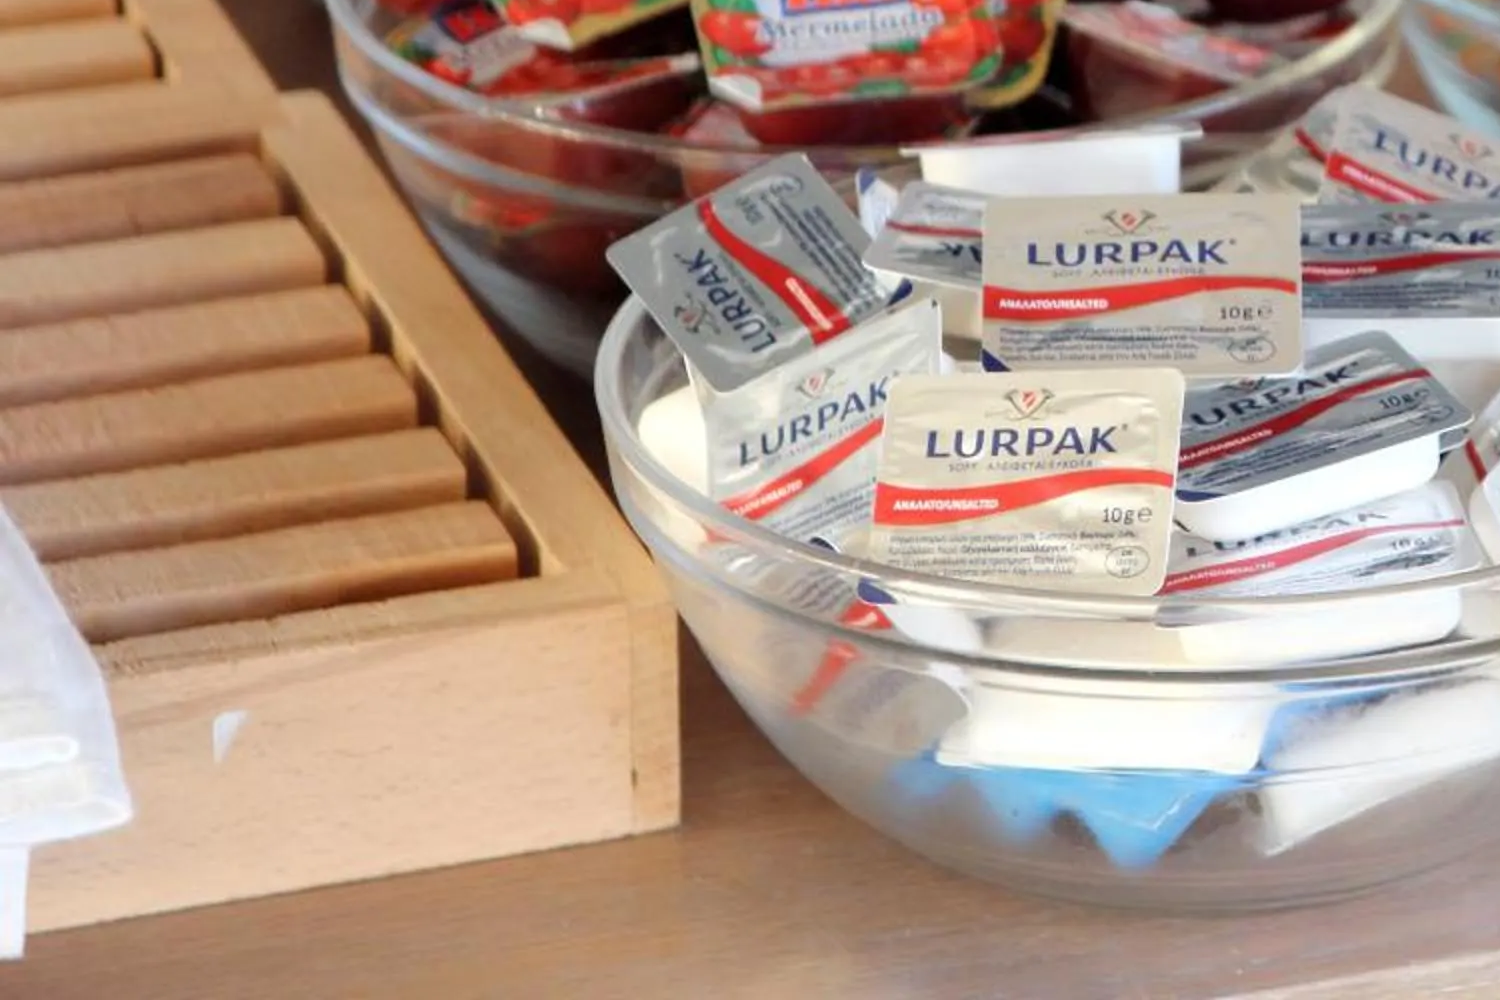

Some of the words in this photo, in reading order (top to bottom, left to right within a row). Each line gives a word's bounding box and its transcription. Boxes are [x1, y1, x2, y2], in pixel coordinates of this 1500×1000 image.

[1026, 238, 1230, 268] LURPAK
[680, 247, 778, 353] LURPAK
[1189, 366, 1352, 427] URPAK
[739, 376, 889, 467] LURPAK
[924, 424, 1119, 459] LURPAK
[1101, 507, 1135, 525] 10g
